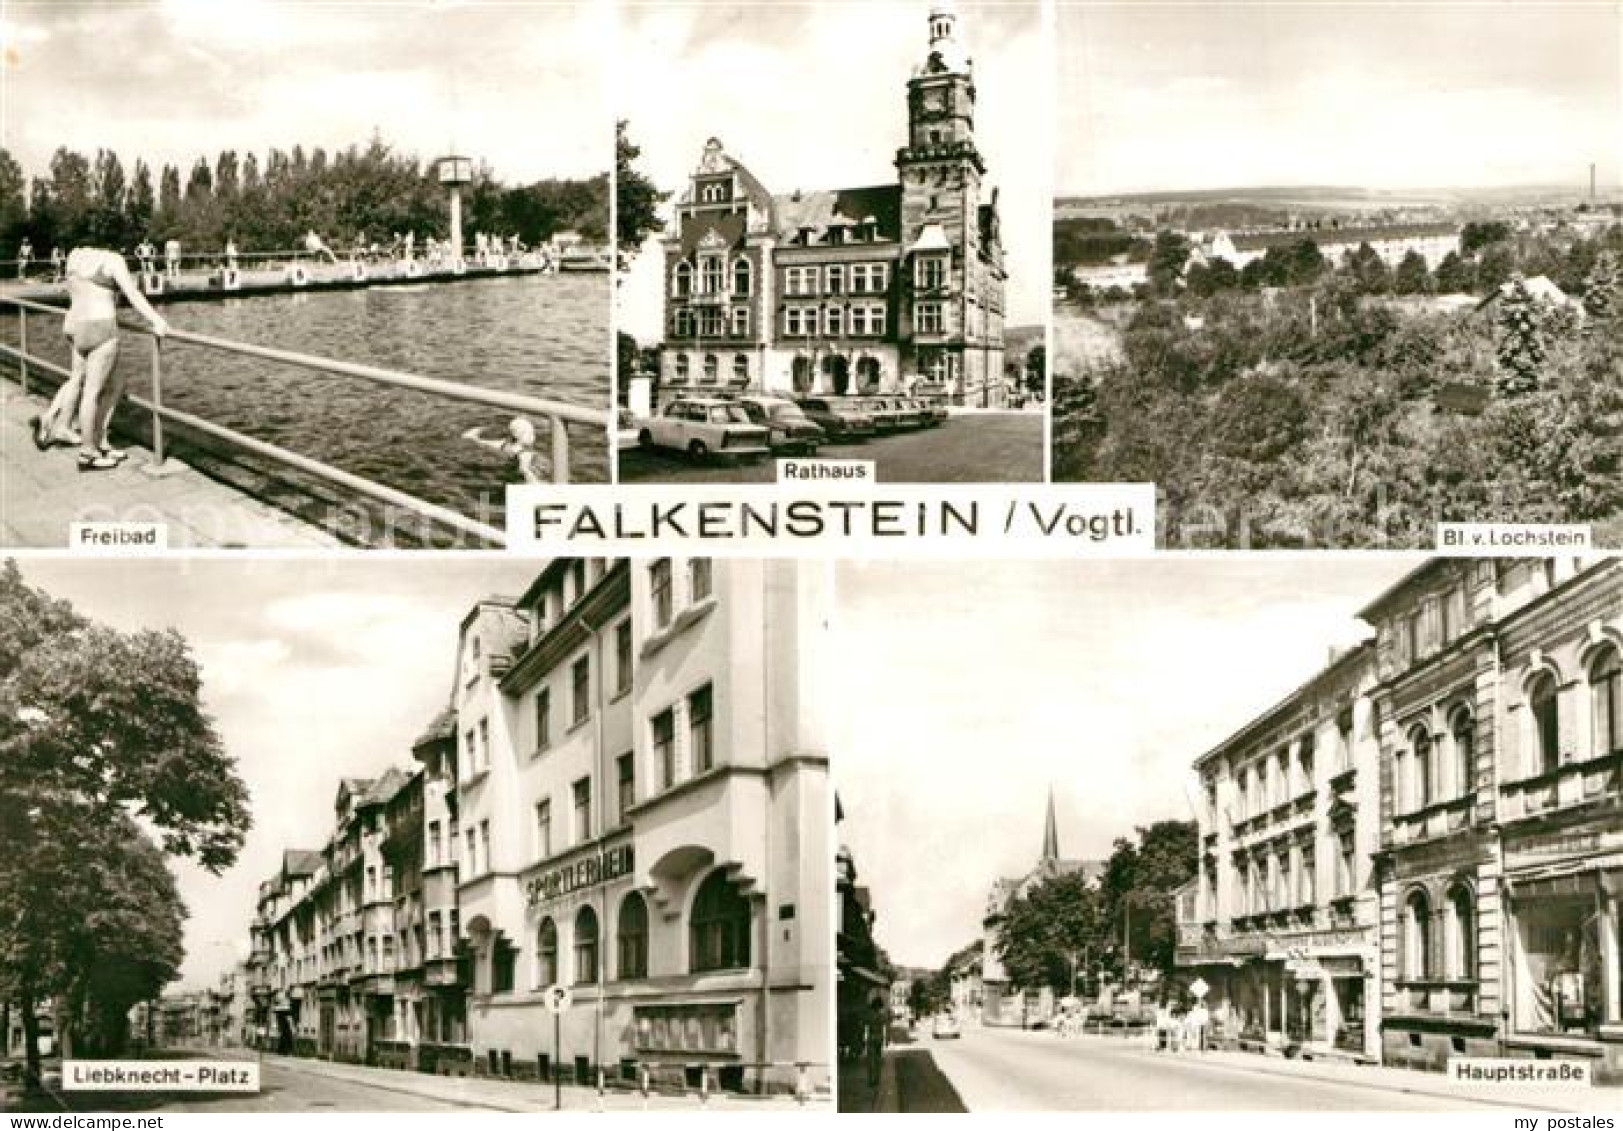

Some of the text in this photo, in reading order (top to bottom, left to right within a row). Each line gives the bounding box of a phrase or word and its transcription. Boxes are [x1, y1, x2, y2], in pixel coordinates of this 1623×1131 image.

[784, 462, 867, 480] Rathaus
[534, 501, 978, 538] FALKENSTEIN
[1029, 503, 1141, 541] Vogtl.
[81, 528, 156, 546] Freibad
[1490, 529, 1584, 546] Lochstein
[1457, 1063, 1584, 1083] Hauptstraße
